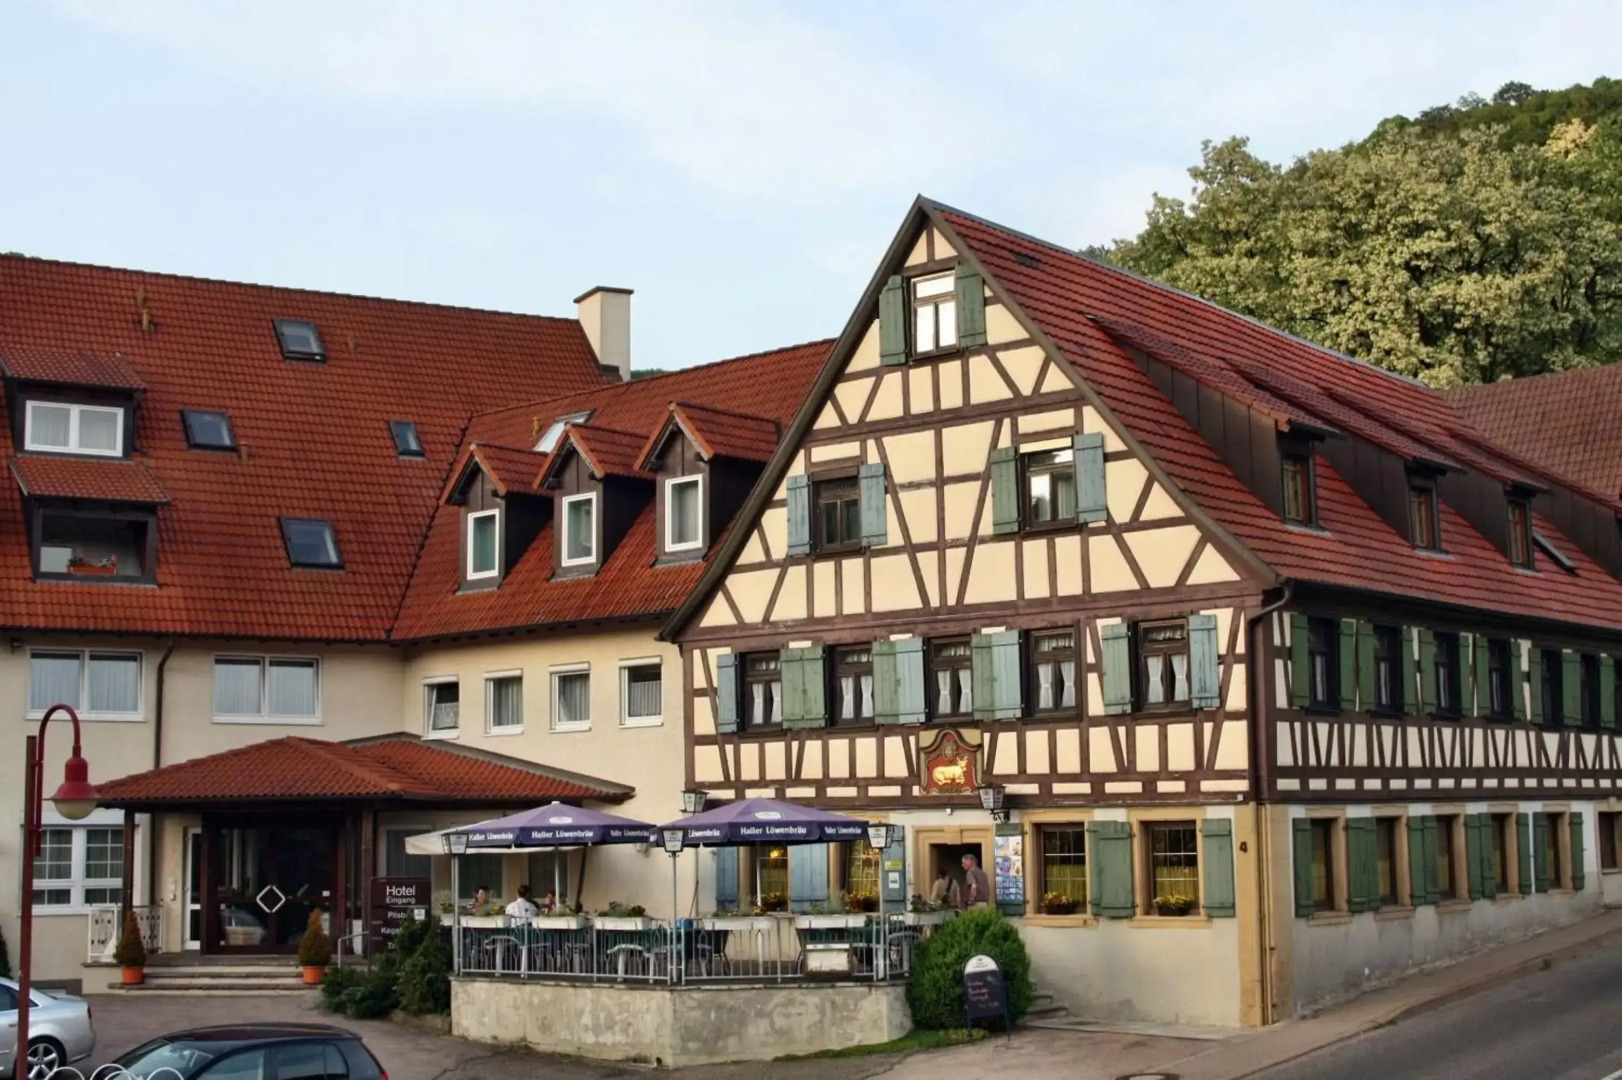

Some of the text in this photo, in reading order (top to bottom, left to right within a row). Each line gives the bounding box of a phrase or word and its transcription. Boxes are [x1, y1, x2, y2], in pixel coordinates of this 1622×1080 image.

[531, 831, 553, 839] Haller
[740, 825, 807, 835] Haller Löwenbräu
[1239, 841, 1248, 853] 4
[386, 885, 416, 896] Hotel
[386, 896, 416, 905] Eingang
